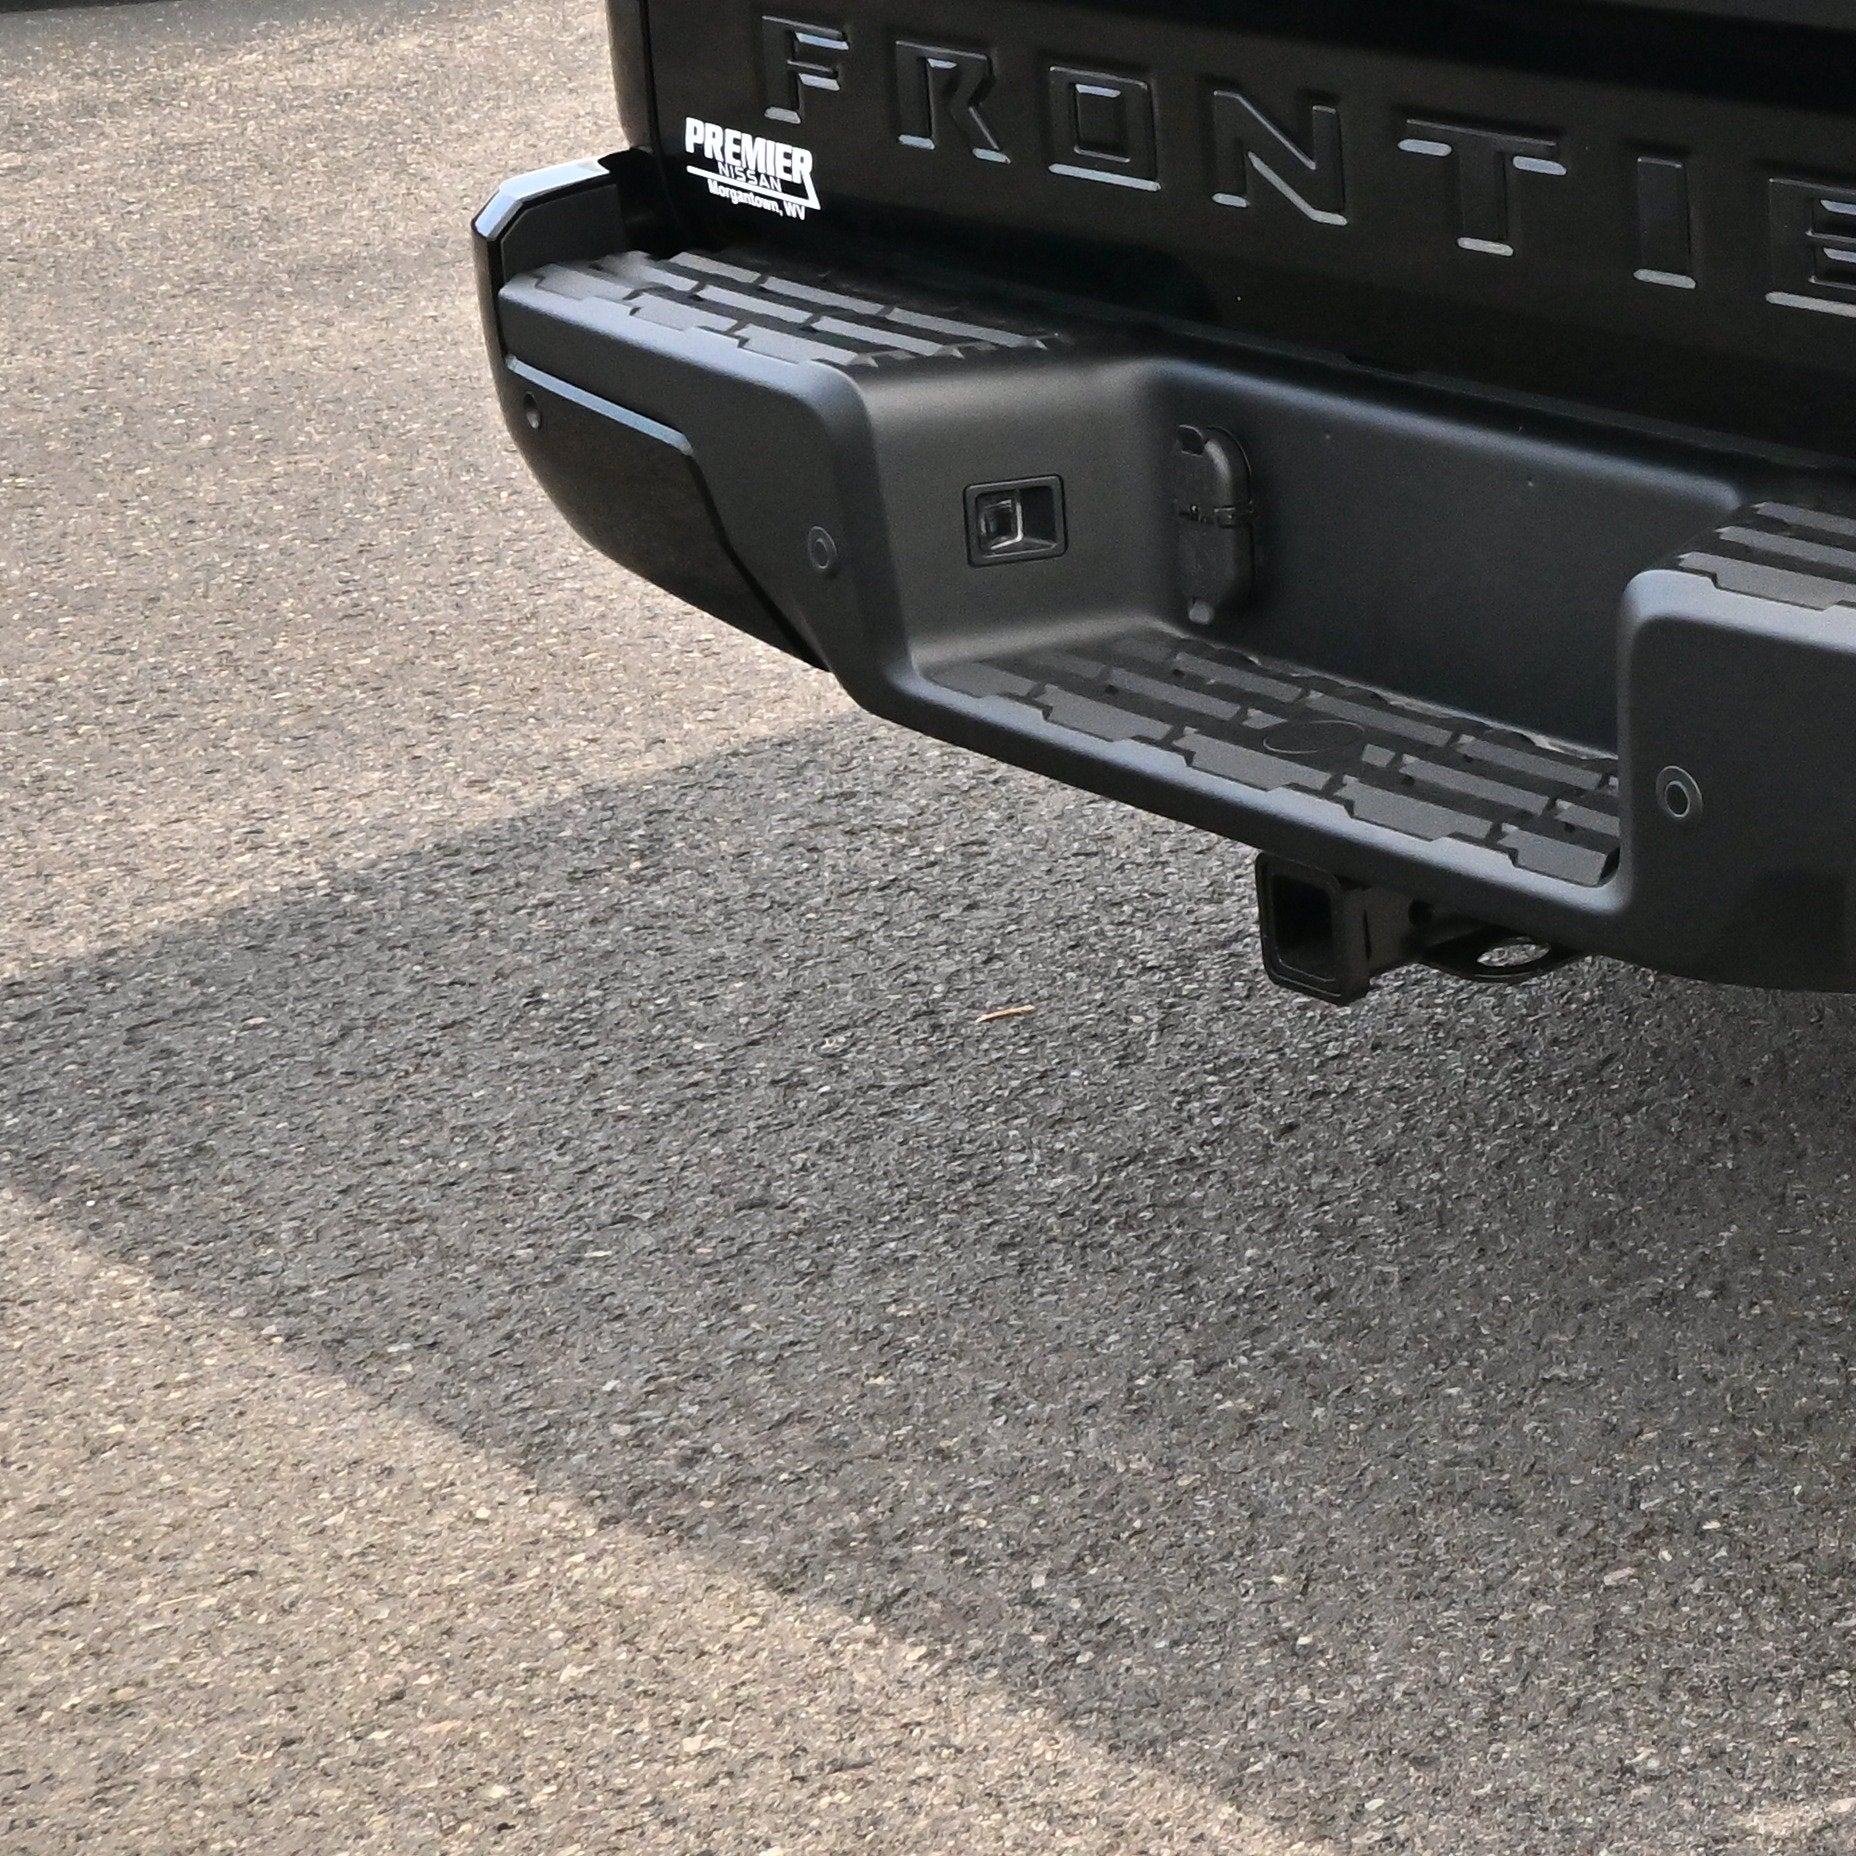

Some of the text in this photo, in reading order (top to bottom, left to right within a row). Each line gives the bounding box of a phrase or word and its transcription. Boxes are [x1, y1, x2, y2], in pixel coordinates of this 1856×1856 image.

[685, 117, 818, 196] PREMIER
[717, 161, 783, 193] NISSAN
[707, 179, 806, 221] Morgantown, WV
